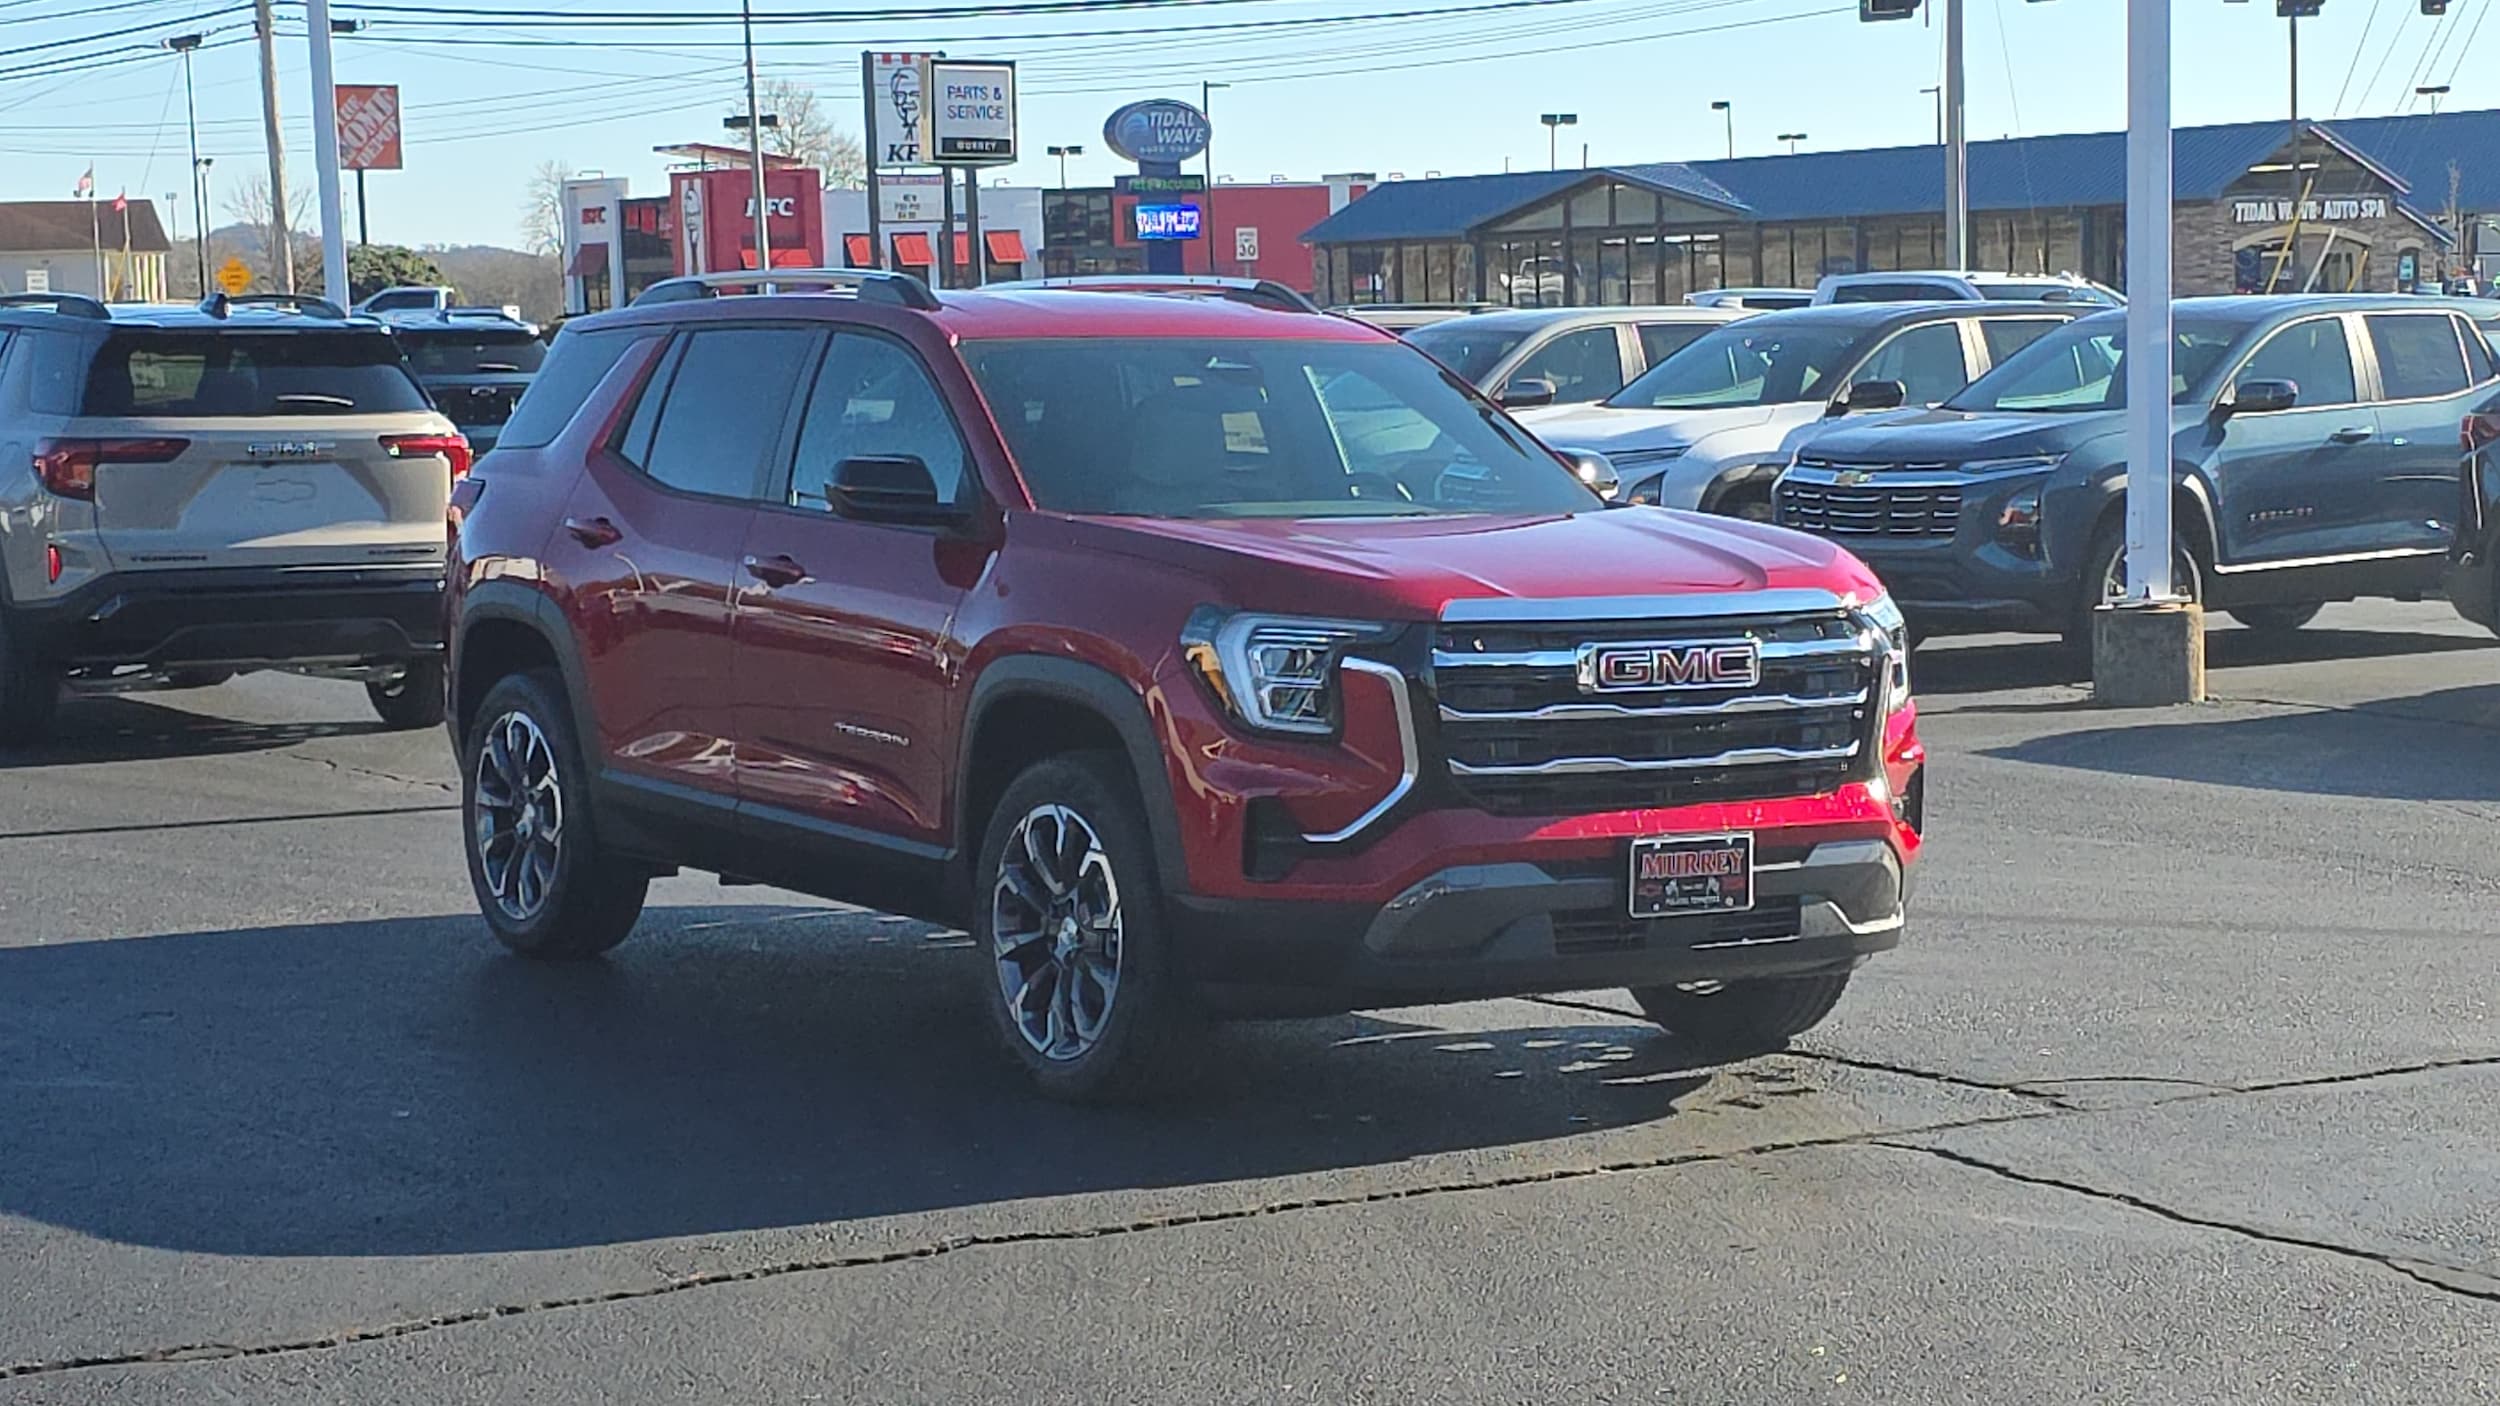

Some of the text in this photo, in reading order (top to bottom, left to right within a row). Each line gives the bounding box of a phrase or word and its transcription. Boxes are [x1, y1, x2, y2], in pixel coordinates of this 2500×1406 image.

[946, 85, 988, 101] PARTS
[947, 104, 1005, 120] SERVICE
[1149, 112, 1195, 127] TIDAL
[1156, 128, 1205, 144] WAVE
[887, 143, 920, 163] KF
[2235, 199, 2386, 222] TIDAL WVE AUTO SPA
[1601, 647, 1752, 686] GMC
[1640, 848, 1745, 879] MURREY
